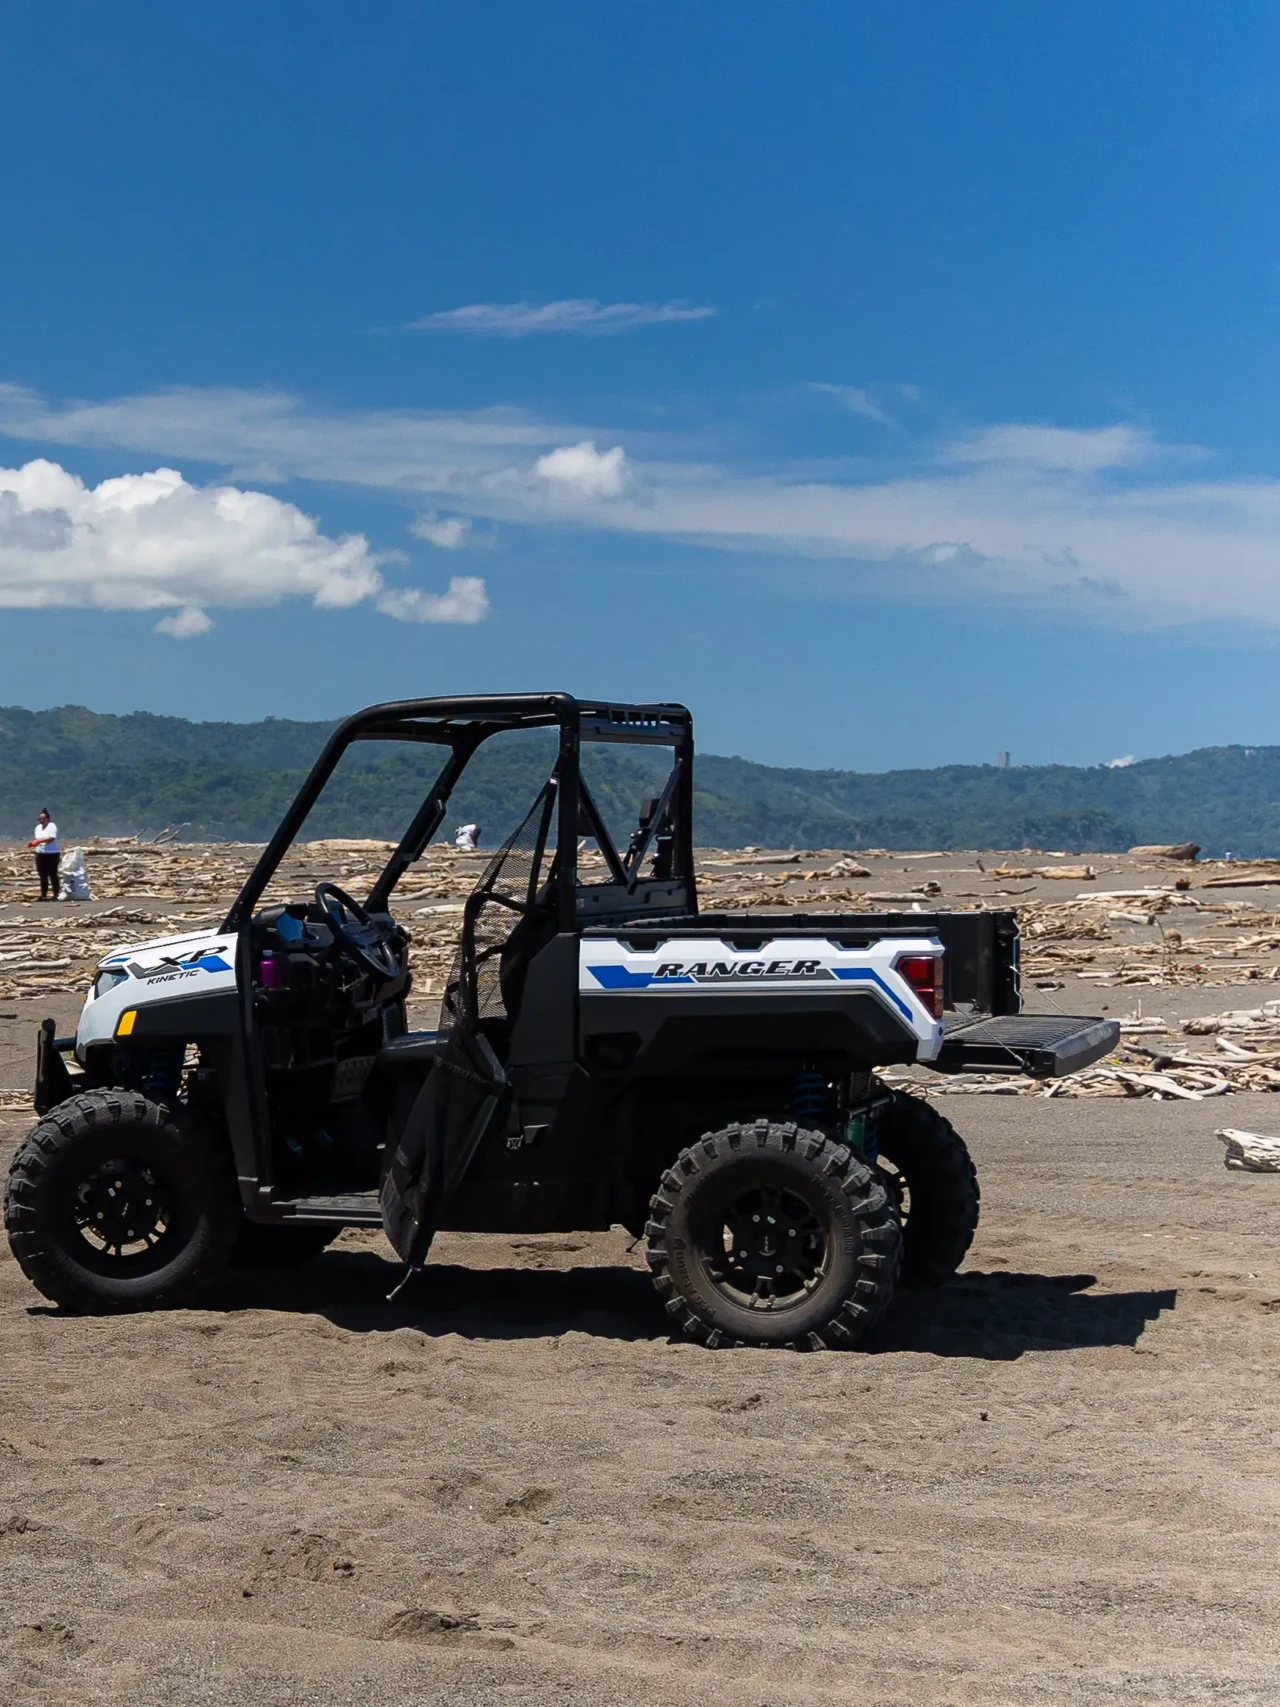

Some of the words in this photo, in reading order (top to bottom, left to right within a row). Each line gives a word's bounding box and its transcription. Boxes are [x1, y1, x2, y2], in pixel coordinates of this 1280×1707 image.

[144, 945, 229, 974] XP
[652, 959, 822, 978] RANGER
[146, 969, 200, 986] KINETIC
